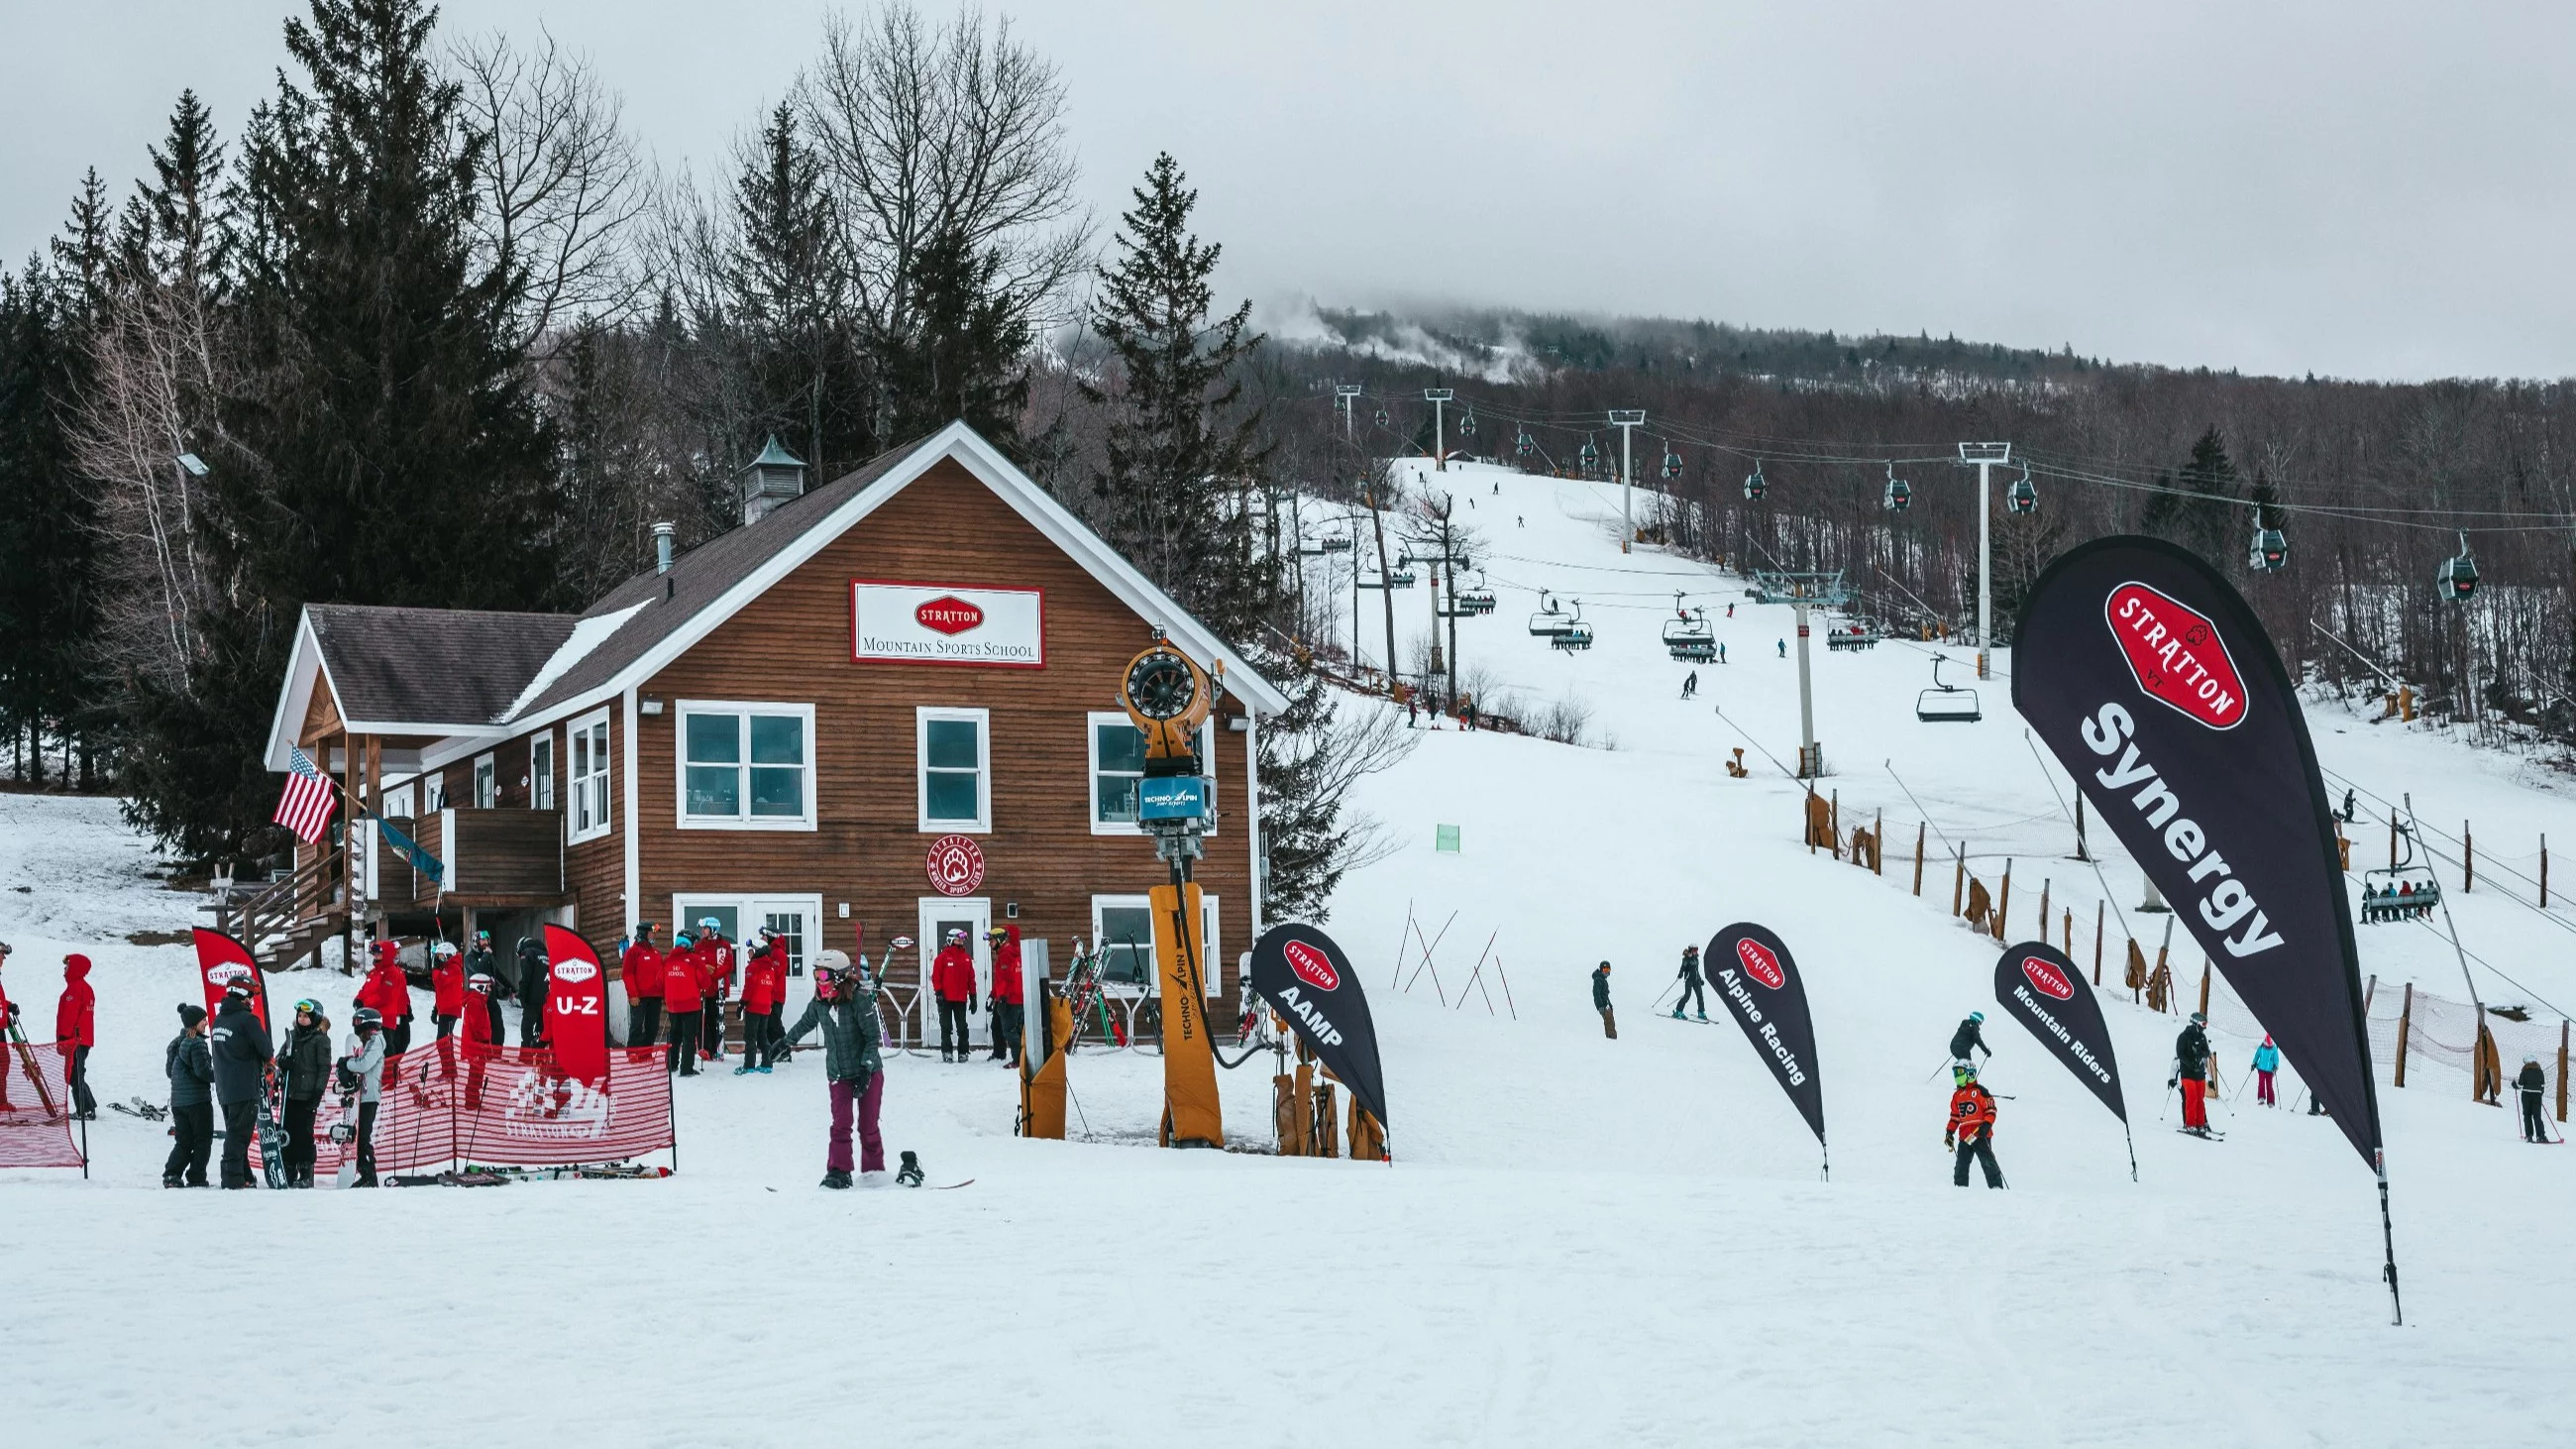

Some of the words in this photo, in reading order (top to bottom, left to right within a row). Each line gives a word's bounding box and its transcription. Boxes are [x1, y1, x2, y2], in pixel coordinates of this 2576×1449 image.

[920, 610, 978, 624] STRATTON
[863, 637, 932, 654] MOUNTAIN
[936, 639, 981, 656] SPORTS
[984, 642, 1035, 657] SCHOOL
[2119, 597, 2235, 716] STRATTON
[2146, 669, 2165, 688] VT
[931, 837, 980, 857] STRATTON
[2081, 702, 2286, 958] Synergy
[1289, 946, 1335, 986] STRATTON
[1741, 943, 1780, 985] STRATTON
[2026, 961, 2069, 995] STRATTON
[556, 996, 598, 1015] U-Z
[1278, 986, 1342, 1046] AAMP
[1719, 967, 1763, 1023] Alpine
[1759, 1022, 1806, 1086] Racing
[2013, 985, 2072, 1045] Mountain
[2070, 1040, 2111, 1083] Riders
